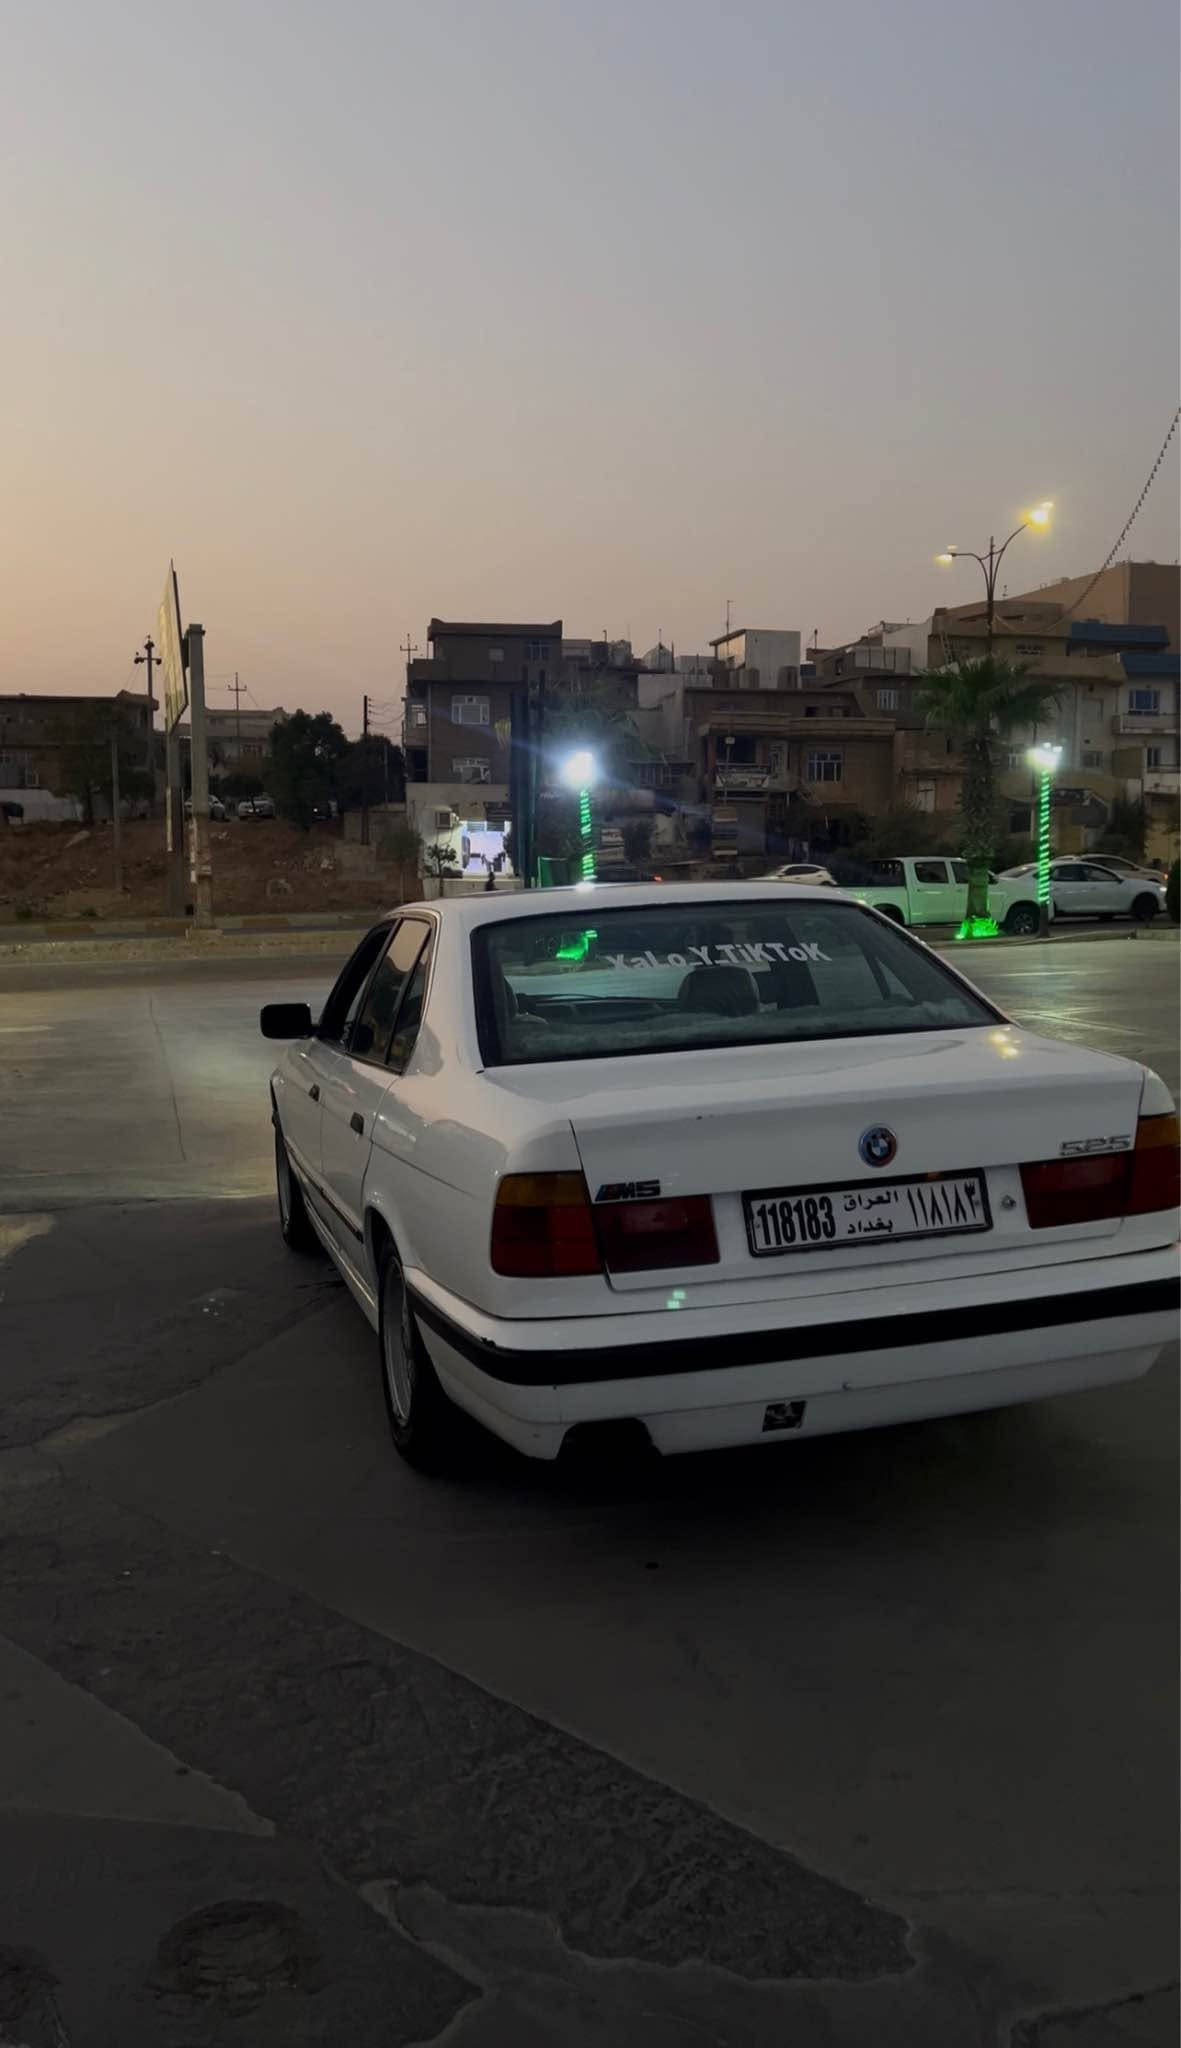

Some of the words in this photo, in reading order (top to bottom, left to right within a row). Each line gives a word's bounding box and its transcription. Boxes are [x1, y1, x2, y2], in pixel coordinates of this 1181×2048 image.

[1061, 1134, 1130, 1155] 525
[608, 1179, 661, 1201] M5
[844, 1190, 899, 1212] العراق
[907, 1181, 977, 1227] ١١٨١٨٣
[757, 1196, 836, 1246] 118183
[848, 1217, 893, 1234] بغداد
